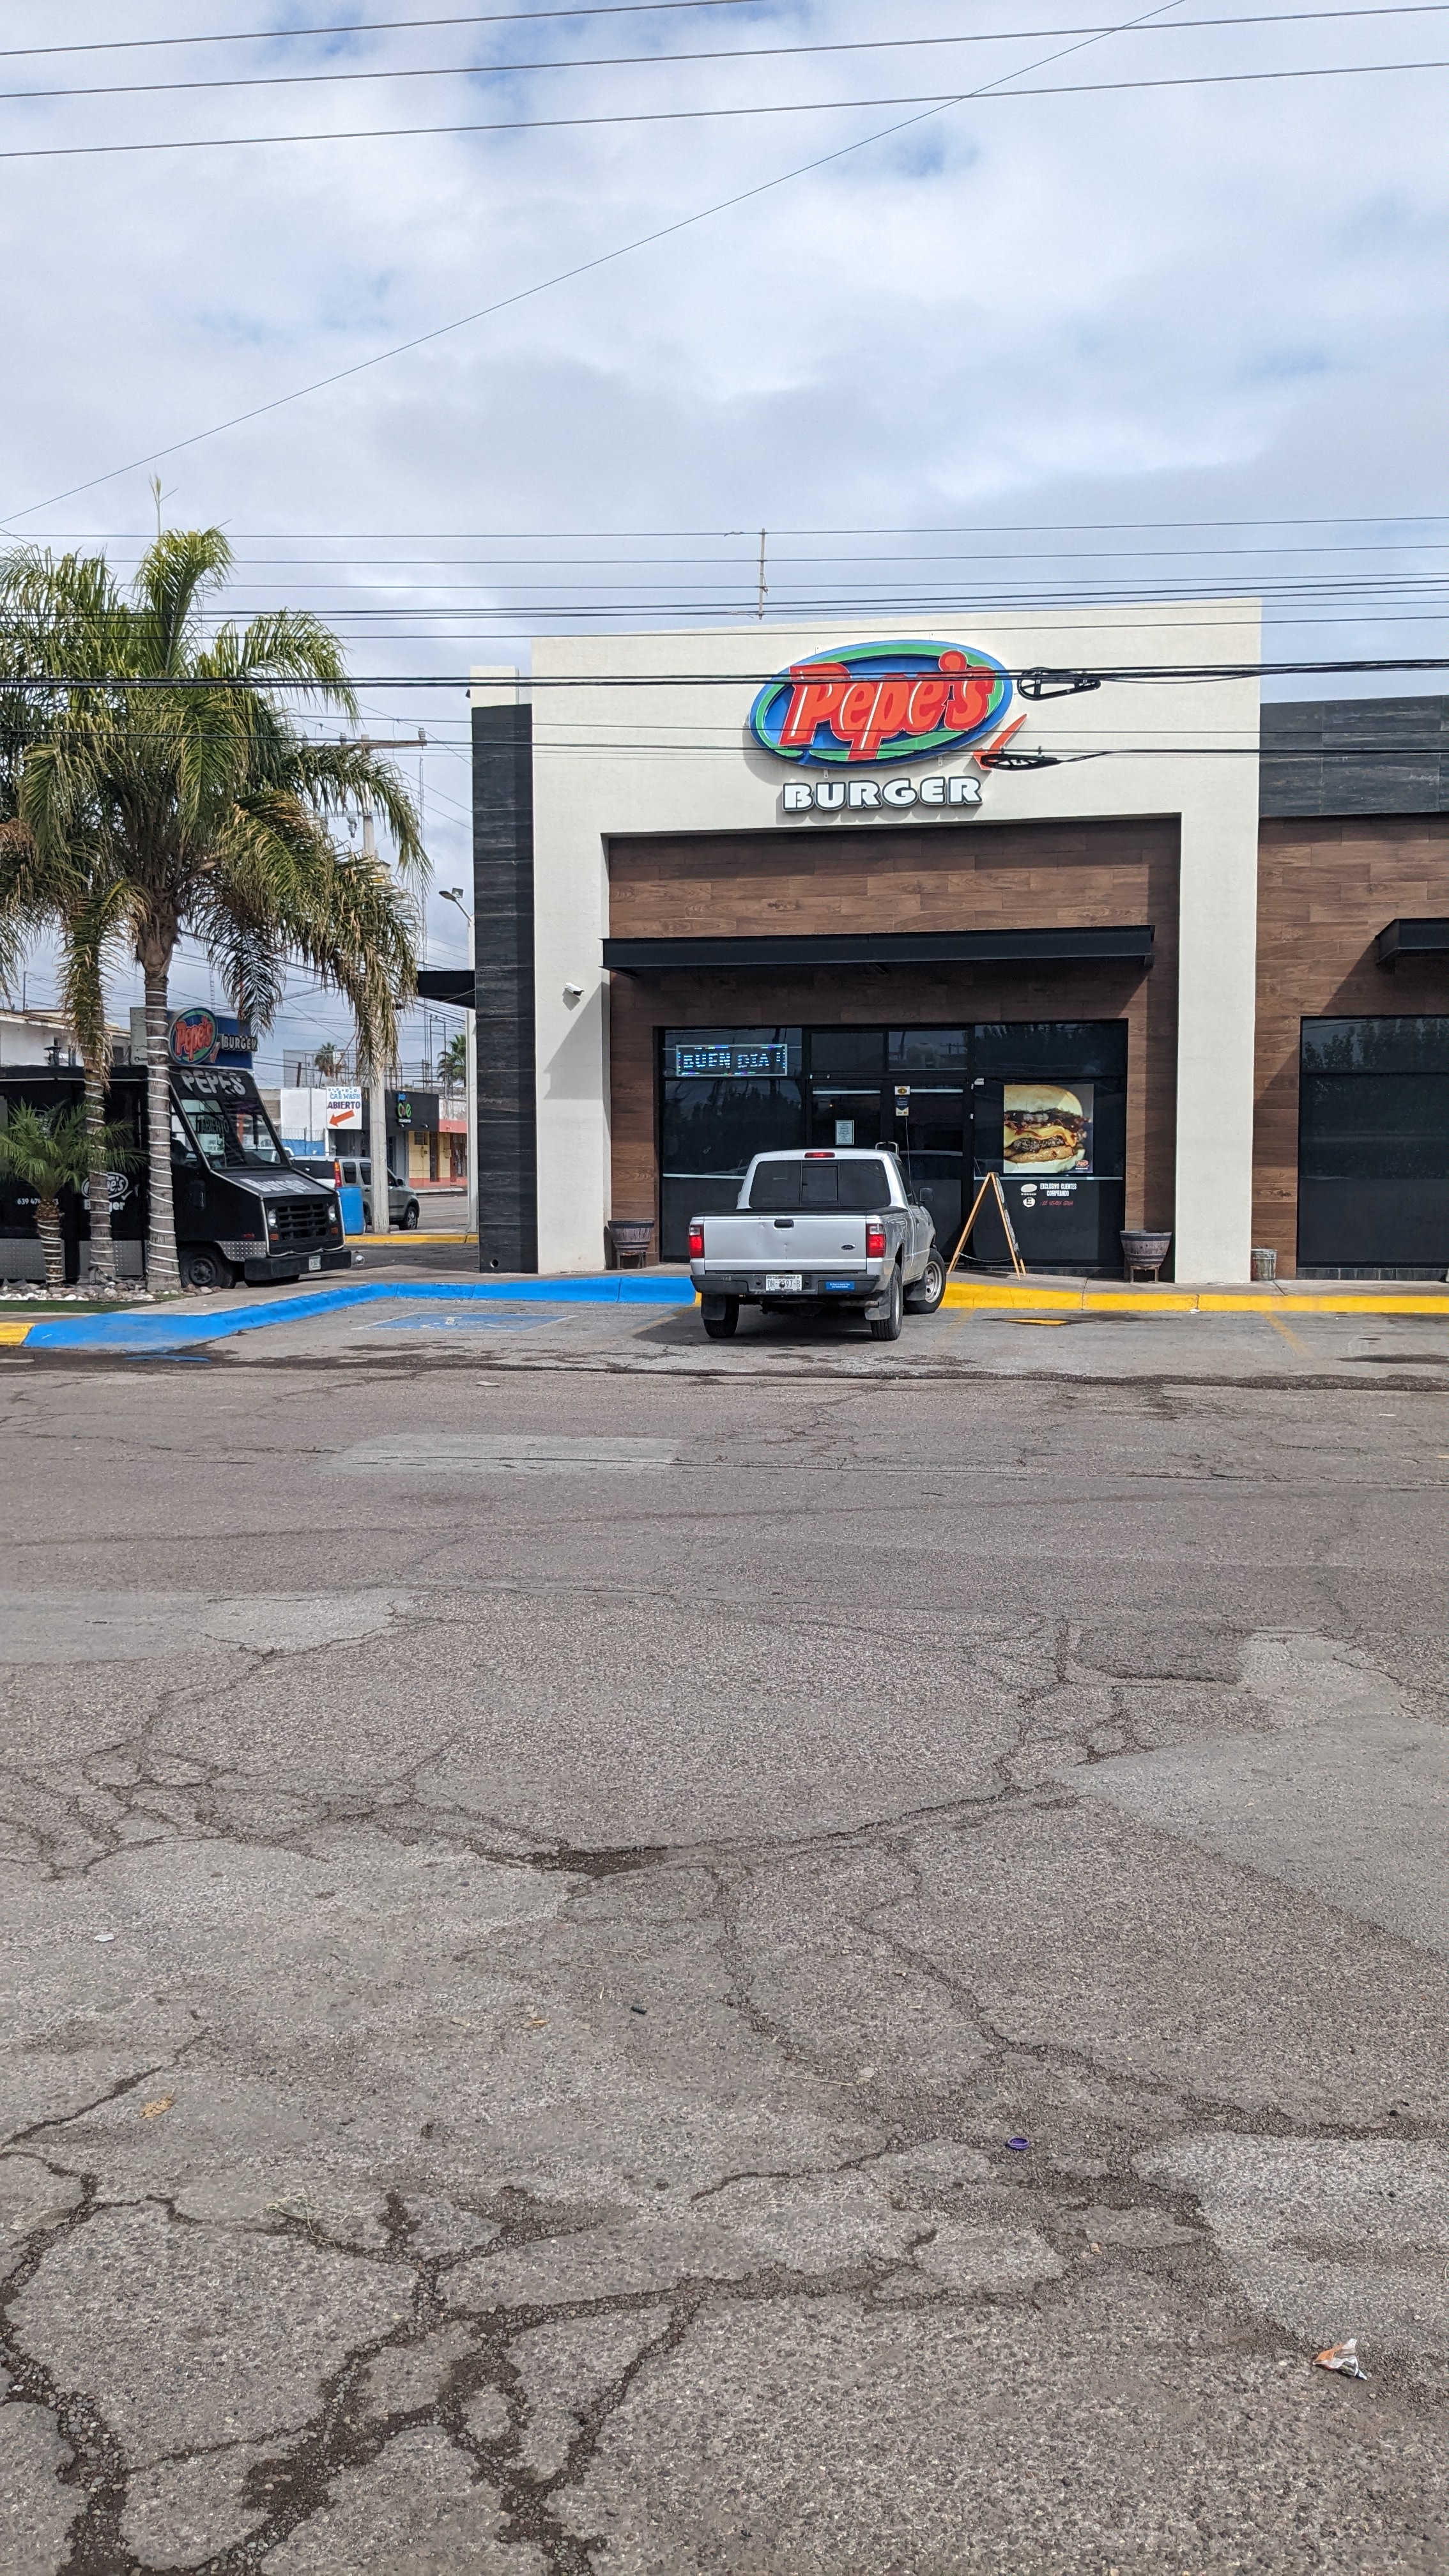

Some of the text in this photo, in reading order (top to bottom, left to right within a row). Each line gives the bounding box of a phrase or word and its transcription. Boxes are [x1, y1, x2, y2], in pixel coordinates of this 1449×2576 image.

[779, 650, 997, 761] Pepe's
[782, 776, 983, 811] BURGER
[174, 1016, 213, 1061] Pepe's
[327, 1101, 361, 1110] ABIERTO
[330, 1091, 342, 1100] CAR
